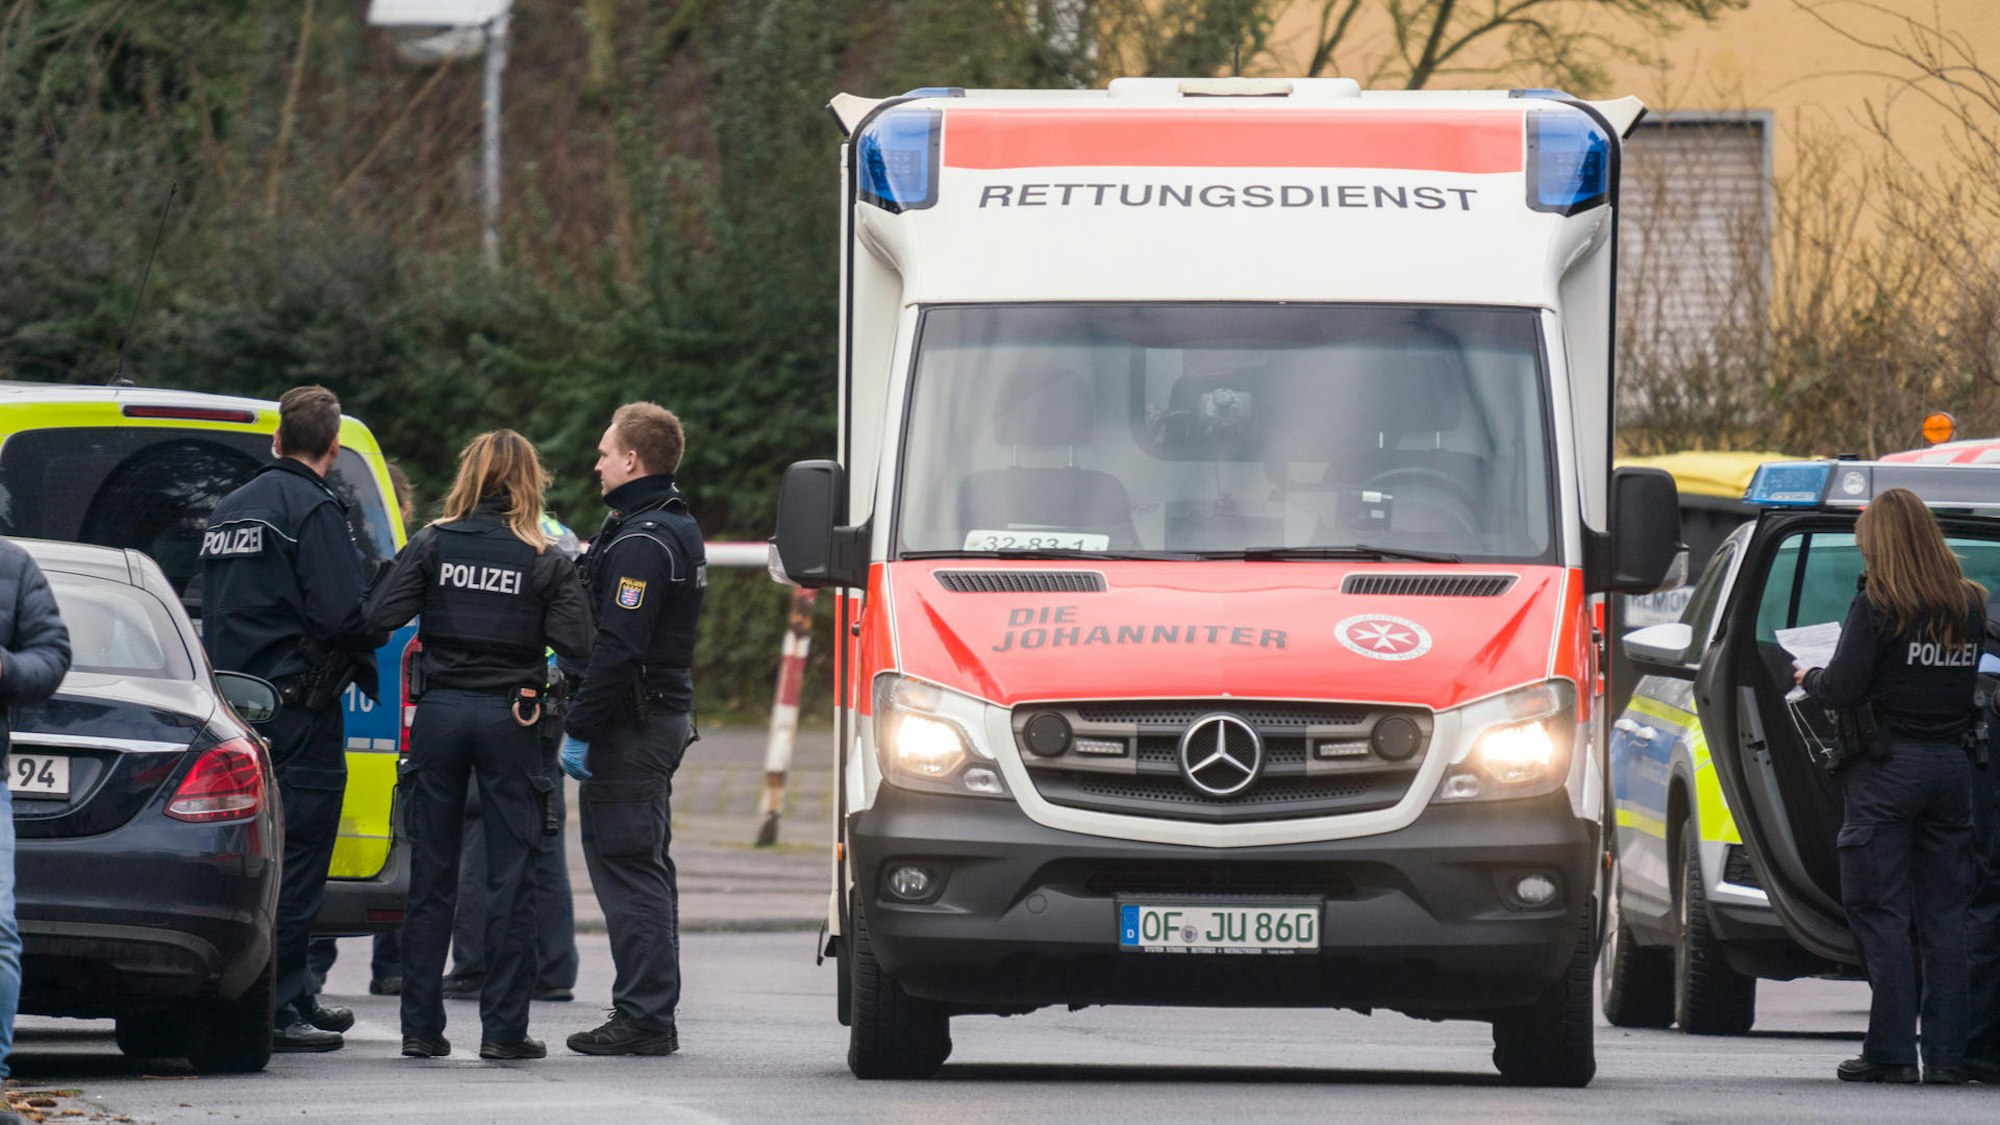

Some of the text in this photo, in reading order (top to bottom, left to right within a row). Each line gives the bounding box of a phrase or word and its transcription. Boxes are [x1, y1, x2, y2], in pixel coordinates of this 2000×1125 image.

[979, 184, 1478, 211] RETTUNGSDIENST
[200, 526, 263, 556] POLIZEI
[439, 562, 522, 595] POLIZEI
[1007, 605, 1078, 627] DIE
[992, 625, 1288, 652] JOHANNITER
[1907, 642, 1978, 667] POLIZEI
[17, 758, 55, 788] 94
[1126, 928, 1135, 939] D
[1142, 911, 1314, 942] OF JU 860
